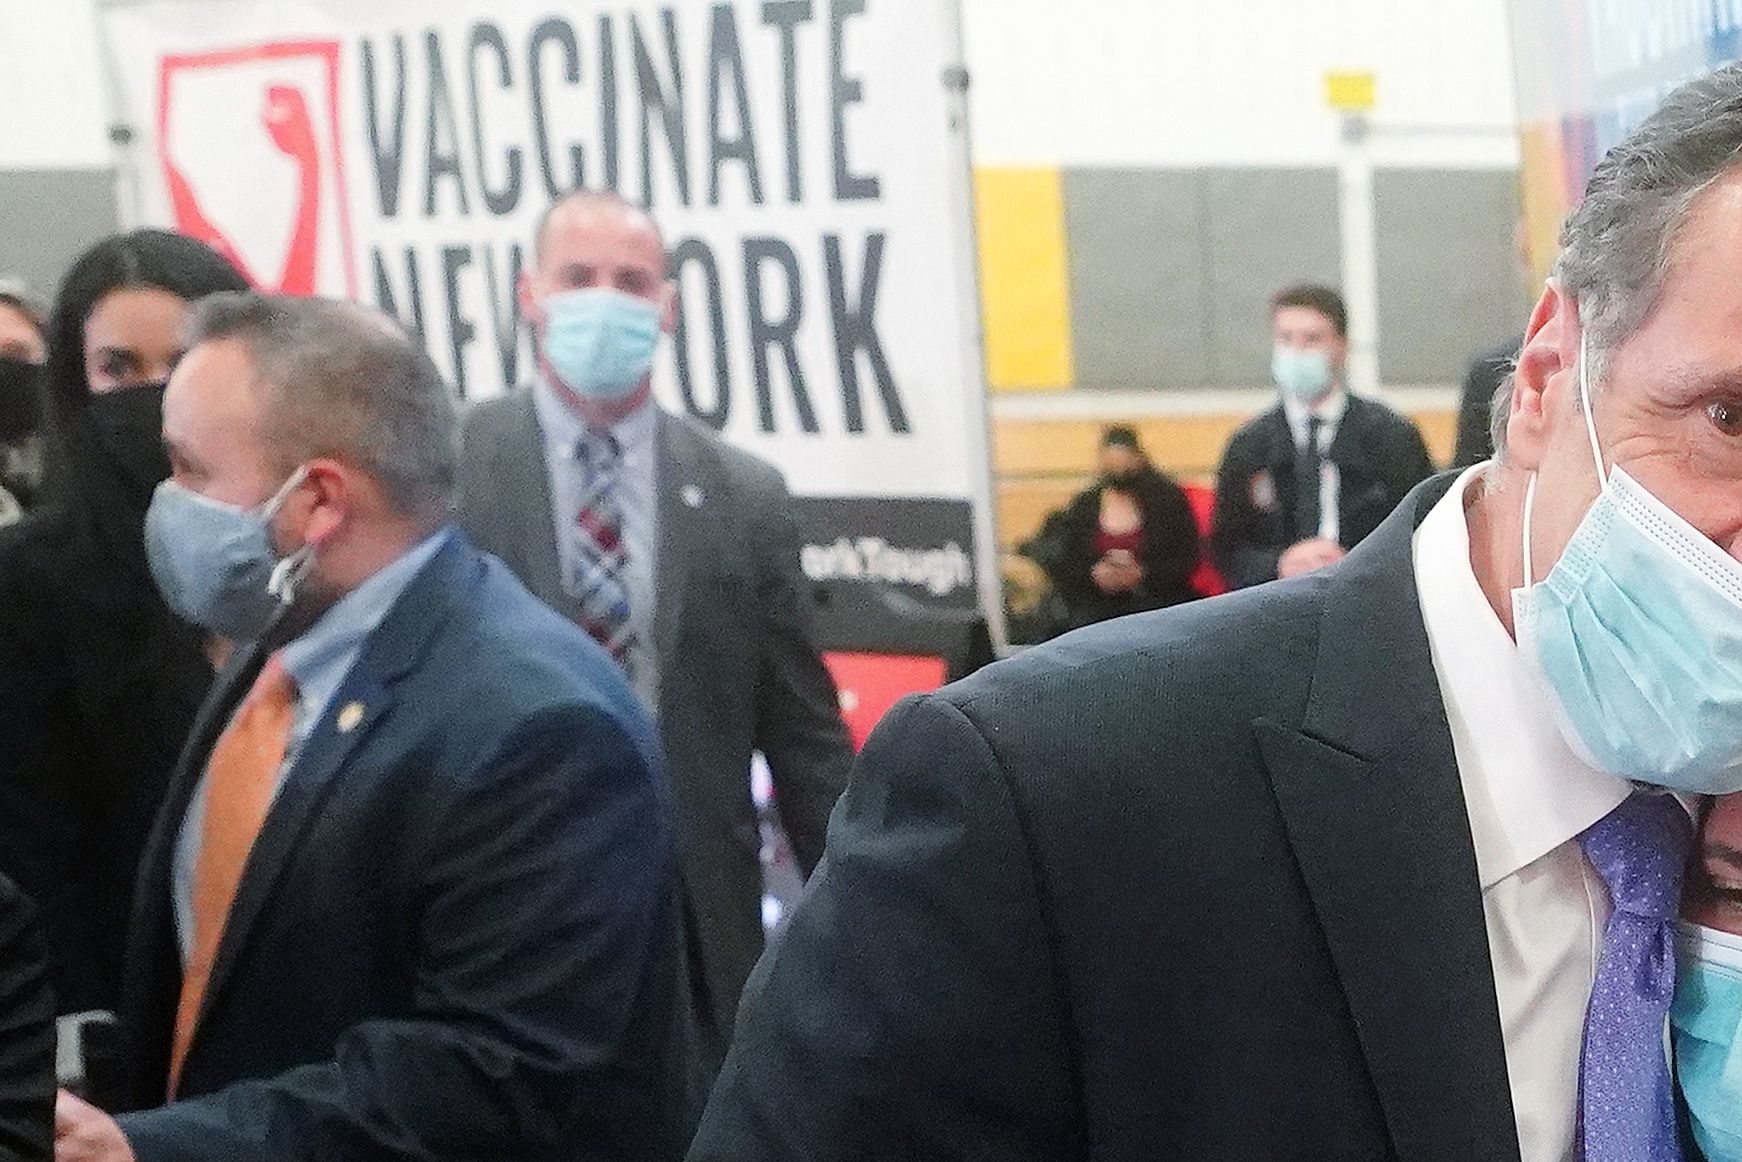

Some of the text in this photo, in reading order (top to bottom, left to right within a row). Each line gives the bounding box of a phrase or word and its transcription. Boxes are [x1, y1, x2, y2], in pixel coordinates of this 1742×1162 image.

[360, 0, 882, 217] VACCINATE
[663, 232, 911, 434] ORK
[800, 537, 972, 596] orkTough
